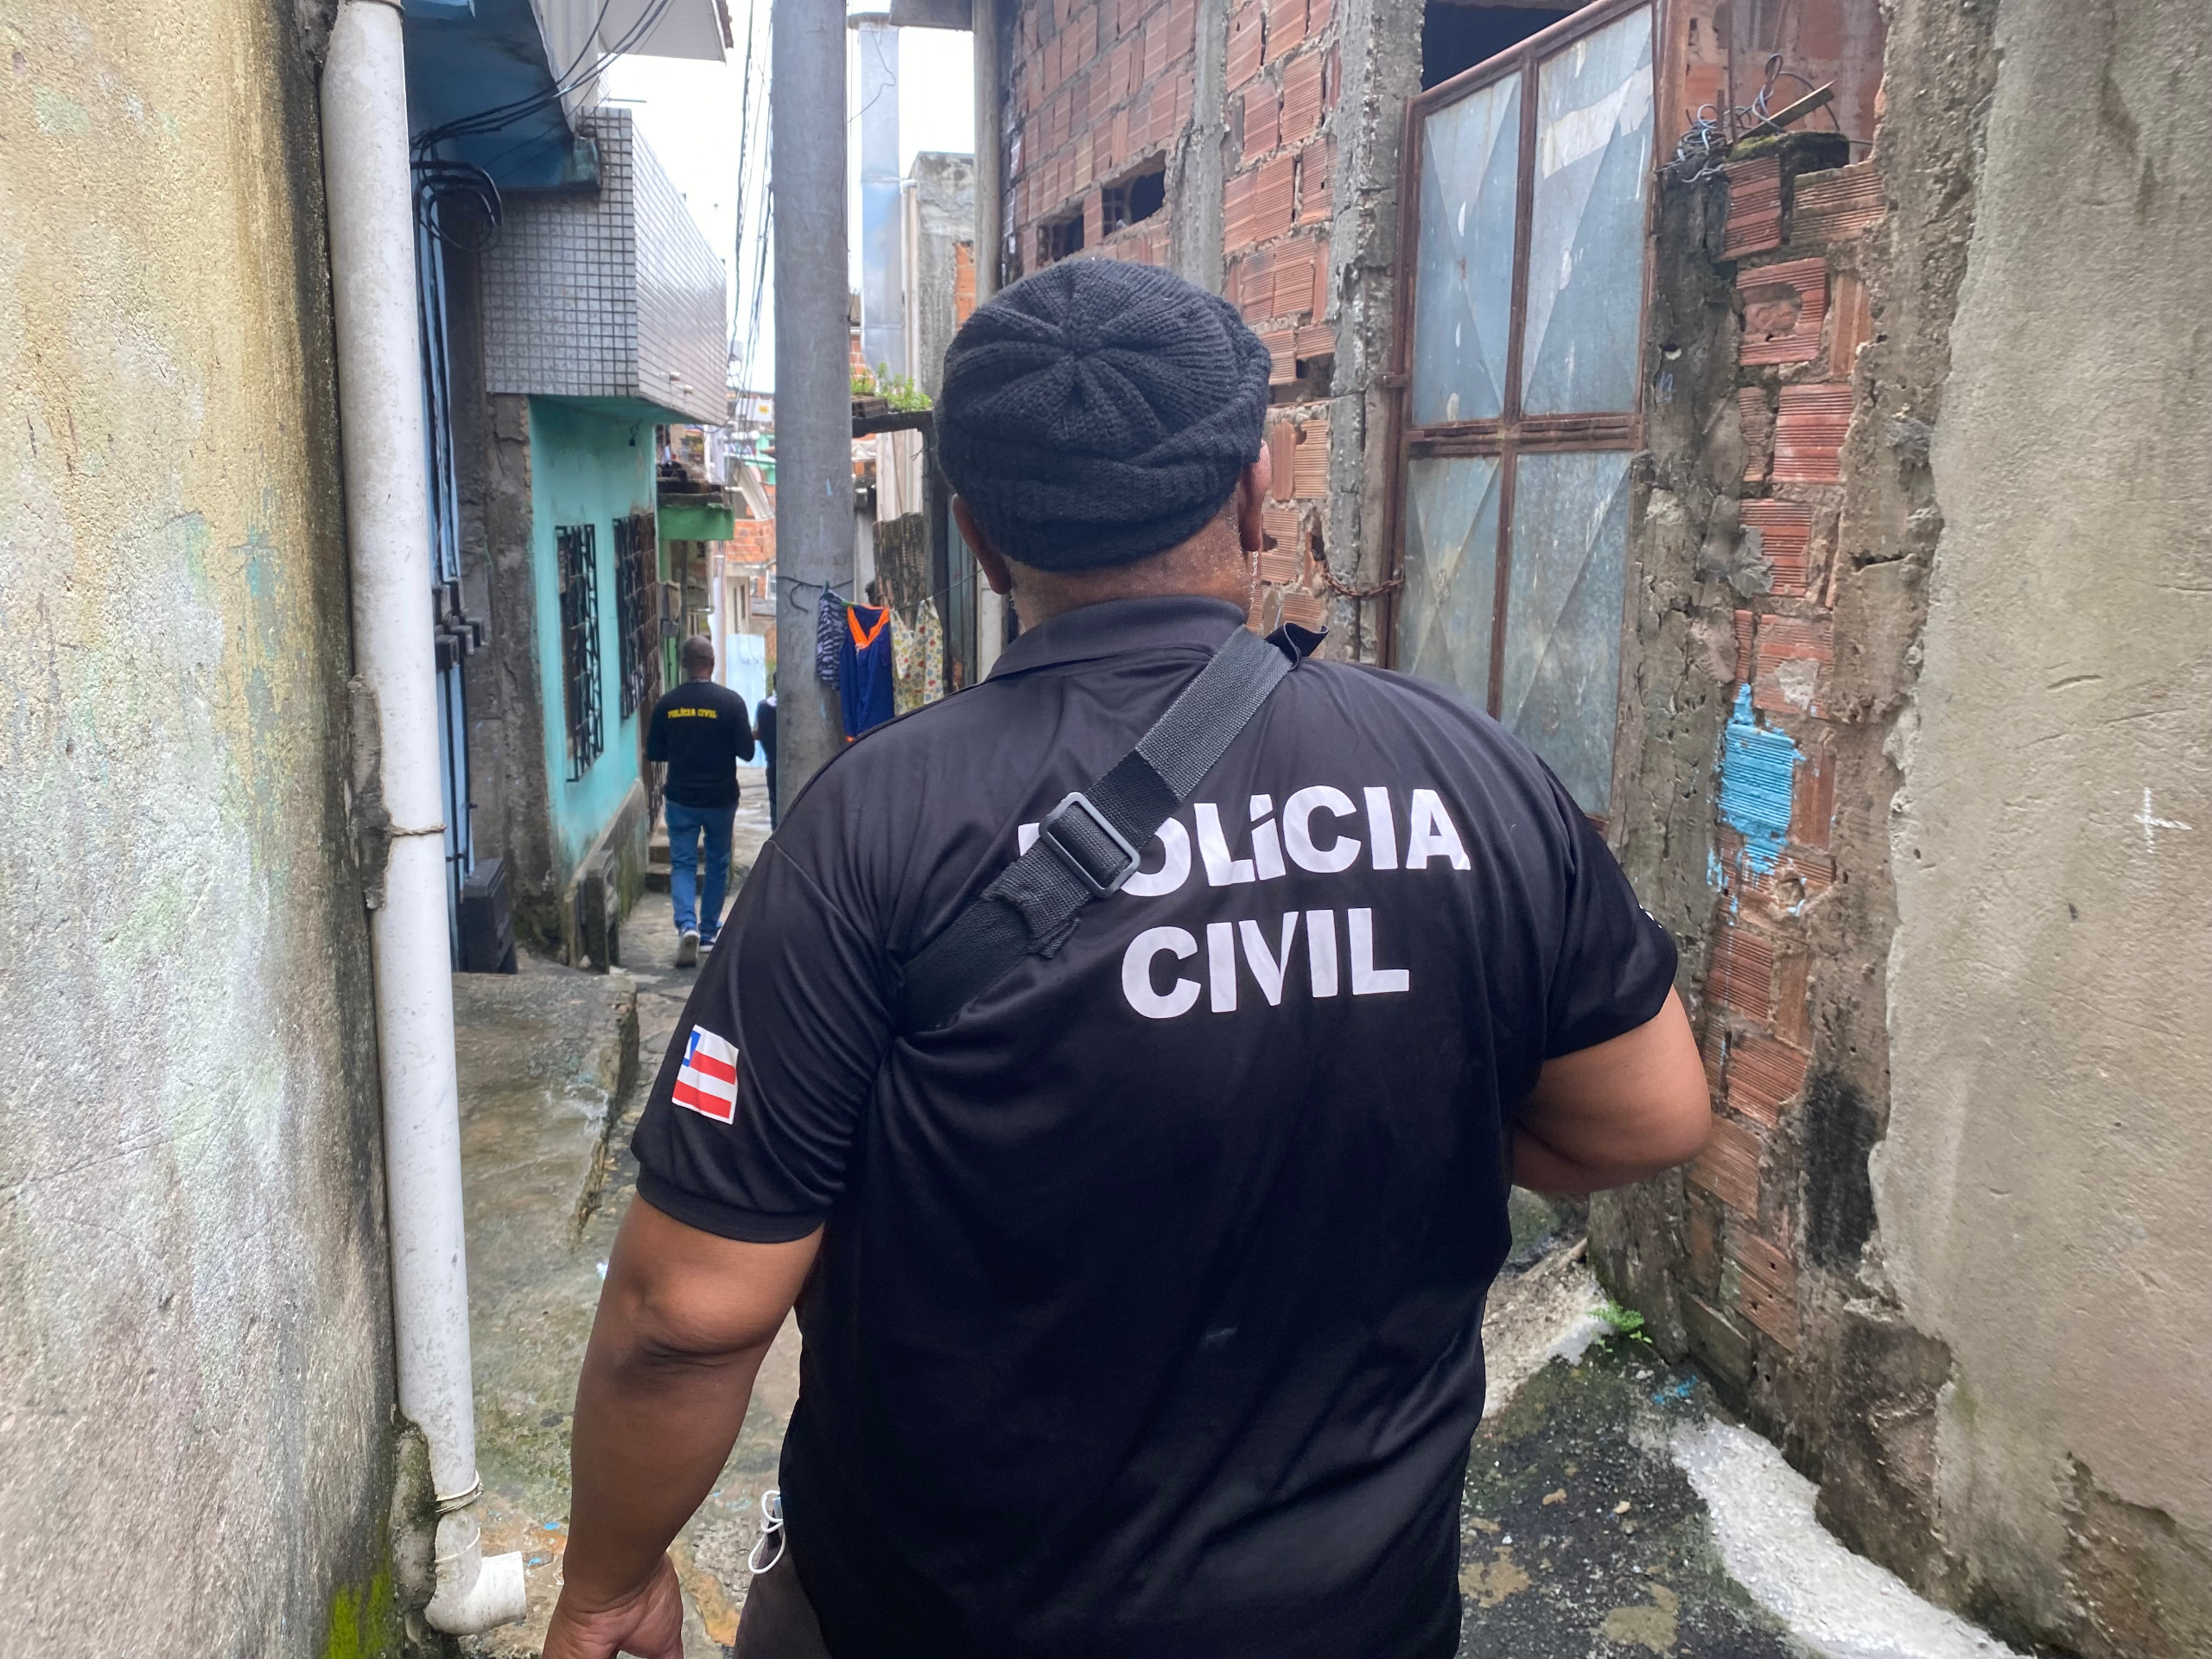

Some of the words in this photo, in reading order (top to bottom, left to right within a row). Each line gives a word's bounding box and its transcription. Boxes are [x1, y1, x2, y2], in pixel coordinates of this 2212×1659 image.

[697, 709, 717, 719] CIVIL
[1018, 785, 1471, 897] OLÍCIA
[1122, 907, 1409, 1019] CIVIL
